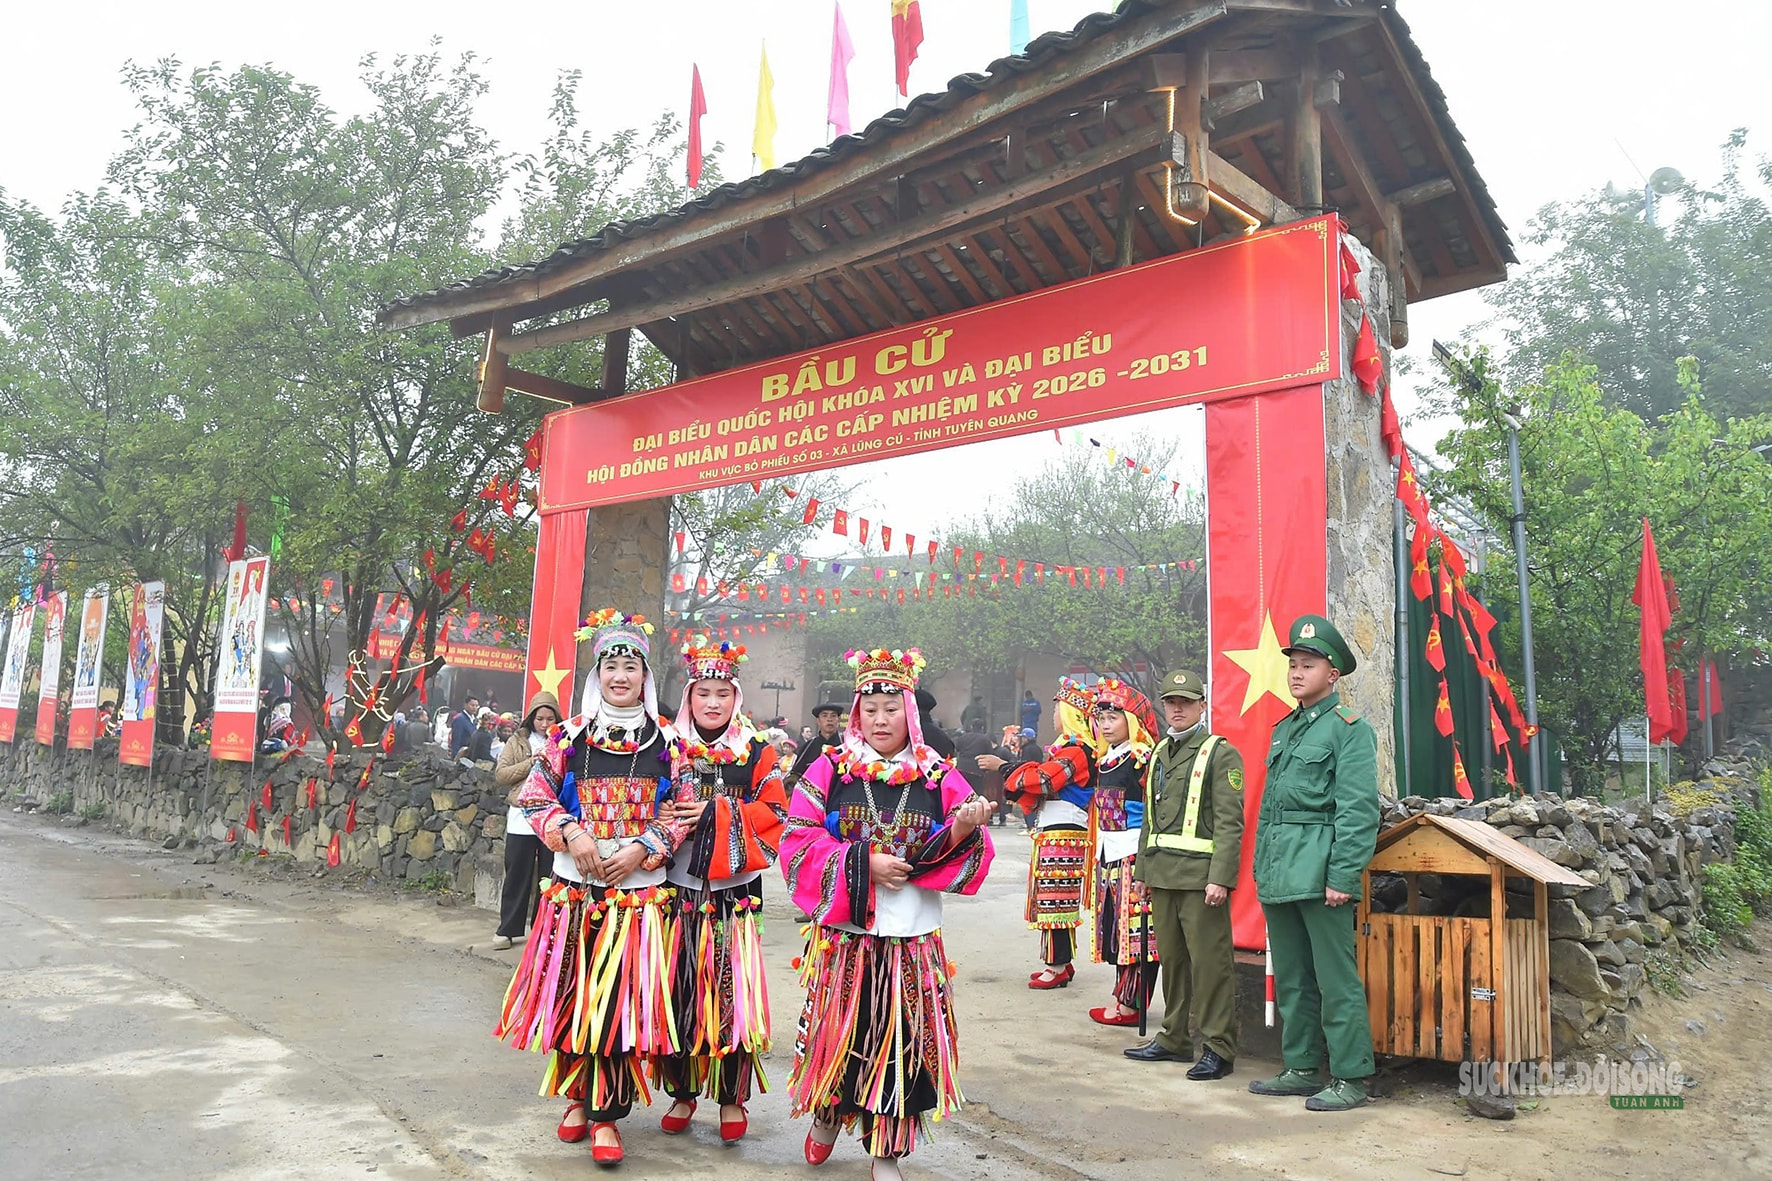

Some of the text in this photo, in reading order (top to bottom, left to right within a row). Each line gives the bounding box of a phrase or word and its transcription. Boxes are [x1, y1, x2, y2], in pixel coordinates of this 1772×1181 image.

[633, 331, 1111, 452] ĐẠI BIỂU QUỐC HỘI KHÓA XVI VÀ ĐẠI BIỂU
[762, 327, 953, 402] BẦU CỬ
[587, 346, 1207, 484] HỘI ĐỒNG NHÂN DÂN CÁC CẤP NHIỆM KỲ 2026 -2031
[699, 466, 718, 478] KHU
[720, 463, 741, 478] VỰC
[744, 459, 758, 471] BỎ
[761, 453, 790, 469] PHIẾU
[792, 447, 807, 463] SỐ
[810, 450, 822, 460] 03
[832, 444, 848, 456] XÃ
[852, 438, 882, 453] LŨNG
[886, 434, 903, 446] CÚ
[914, 427, 941, 442] TỈNH
[945, 418, 984, 436] TUYÊN
[987, 409, 1038, 428] QUANG
